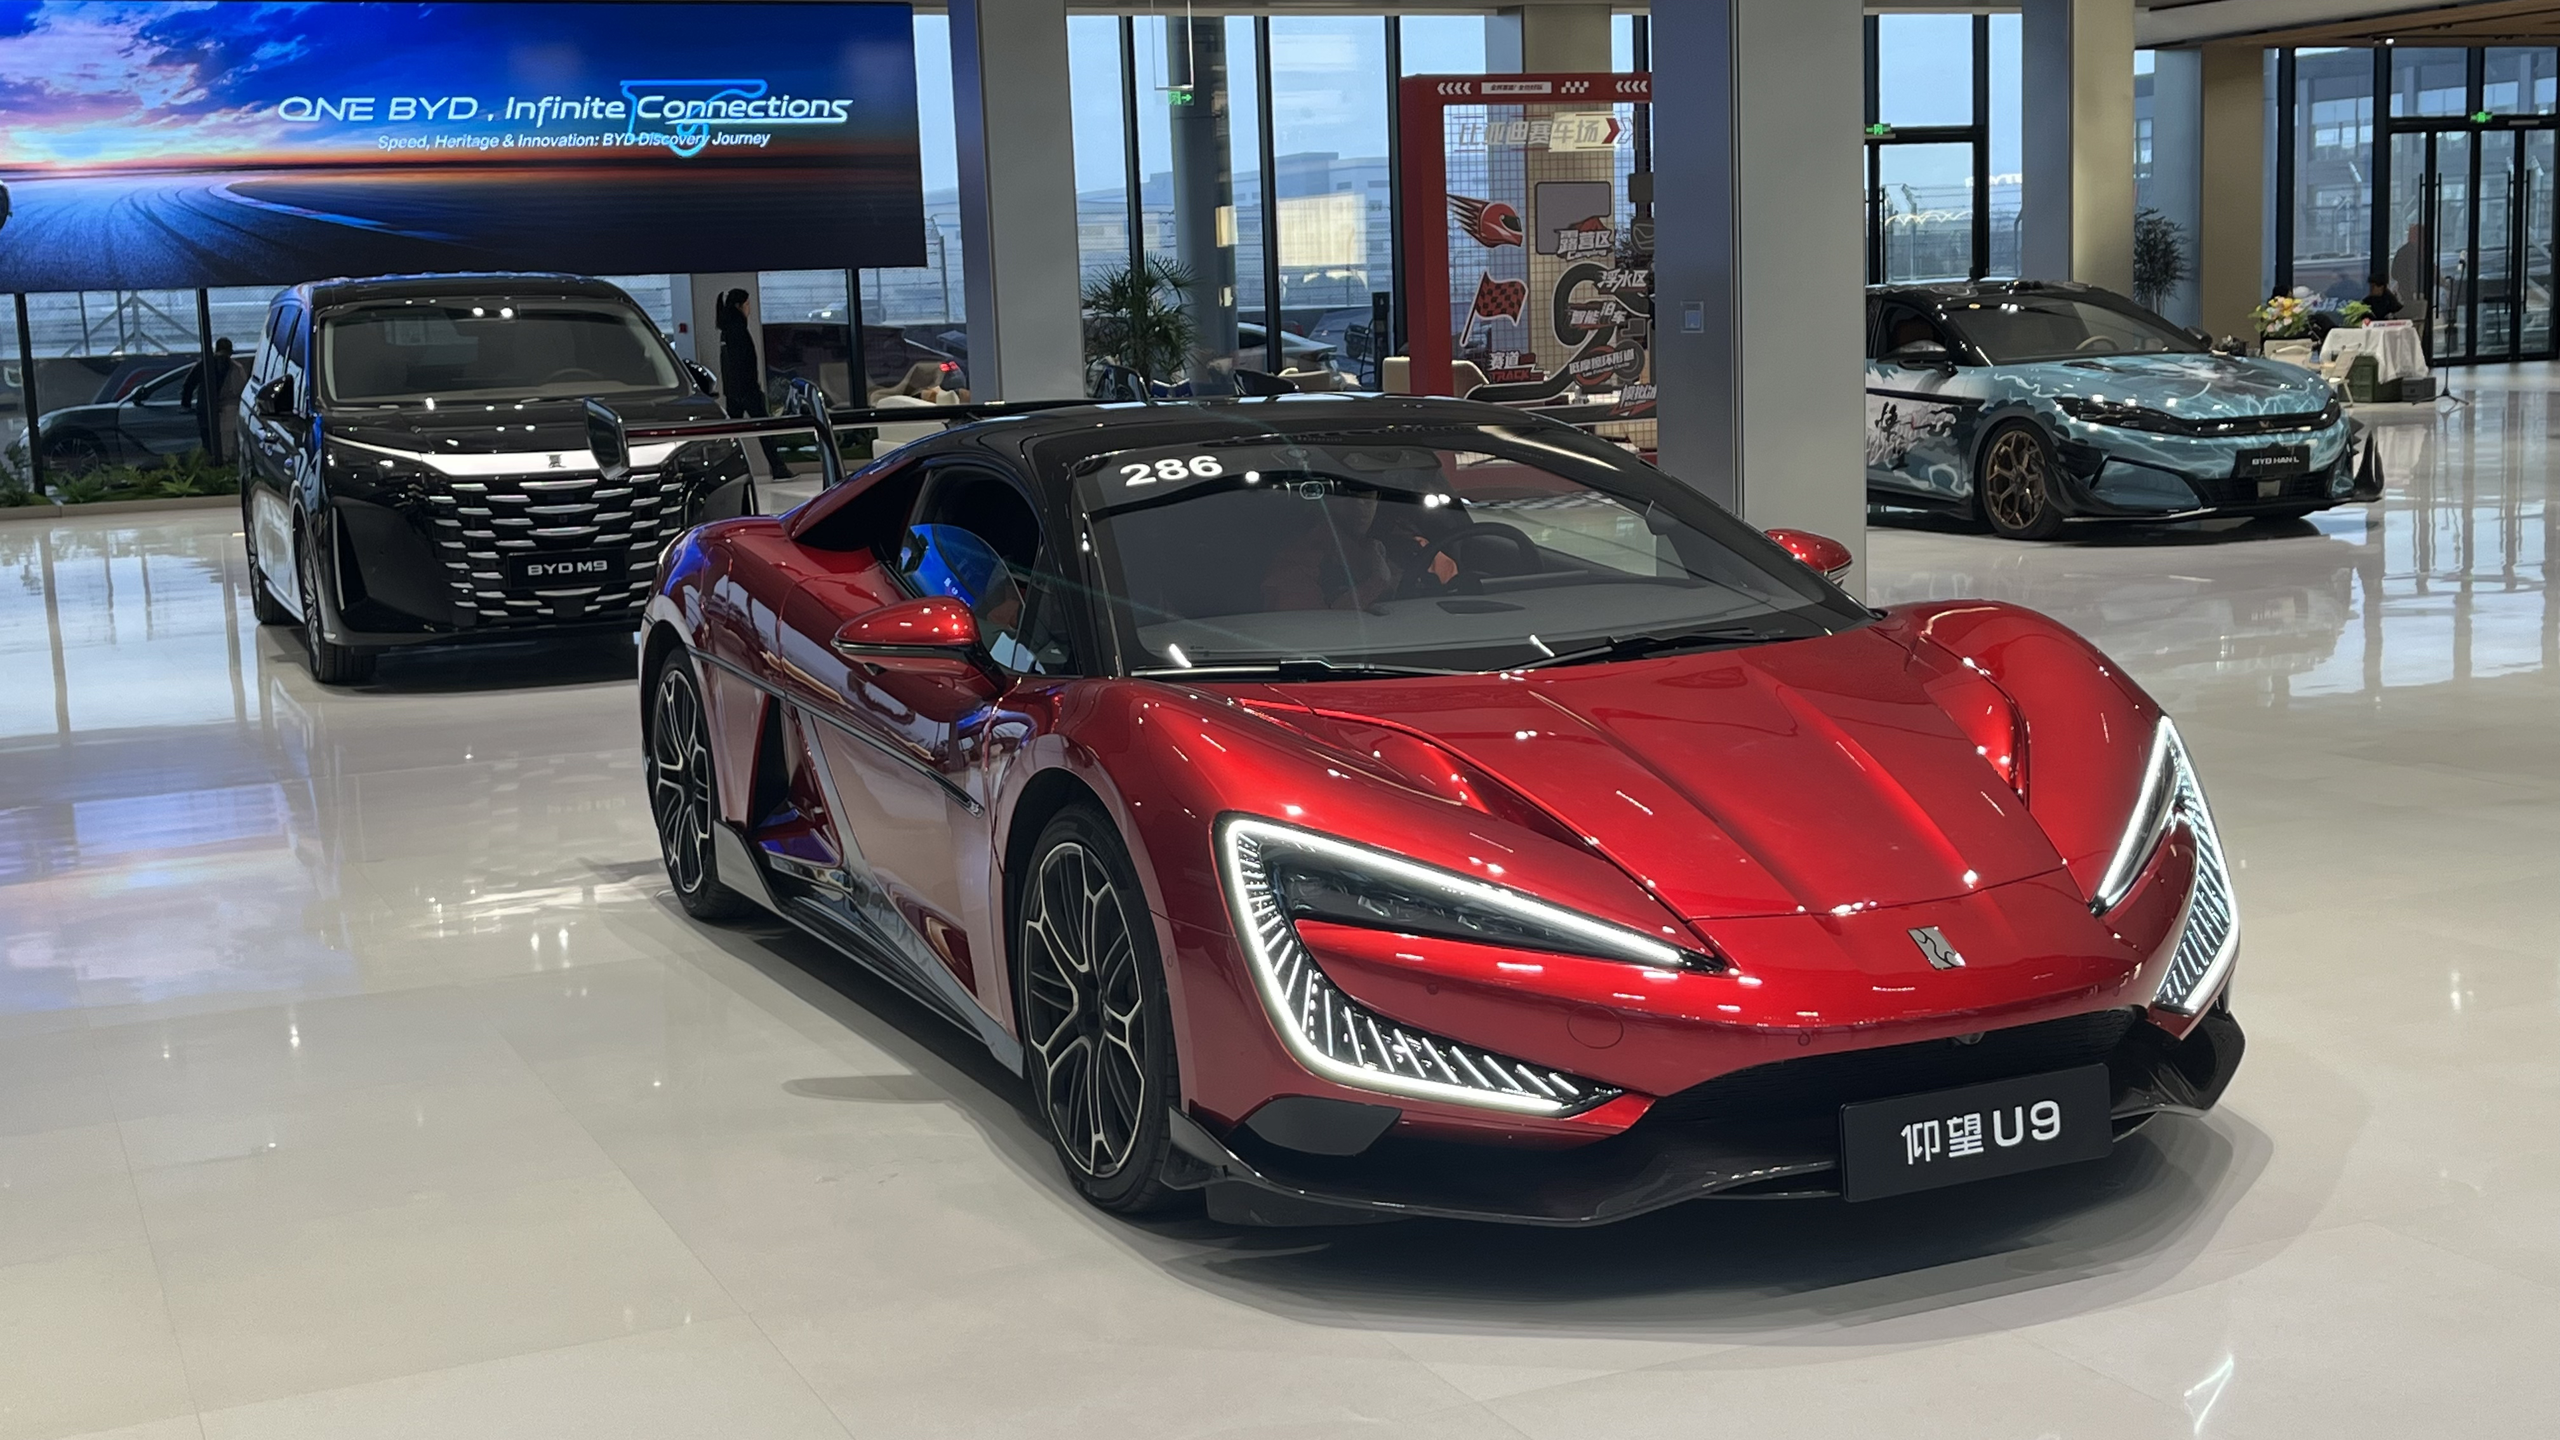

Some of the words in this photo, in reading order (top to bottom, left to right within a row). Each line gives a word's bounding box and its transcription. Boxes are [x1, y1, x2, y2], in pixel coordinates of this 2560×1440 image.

[278, 96, 375, 121] ONE
[388, 96, 479, 121] BYD
[505, 95, 626, 128] Infinite
[637, 94, 854, 123] Connections
[378, 135, 430, 151] Speed,
[434, 134, 499, 151] Heritage
[502, 134, 515, 148] &
[518, 133, 599, 148] Innovation:
[602, 133, 635, 146] BYD
[639, 132, 709, 147] Discovery
[711, 132, 771, 148] Journey
[1458, 118, 1600, 146] 比亚迪赛车场
[1557, 230, 1612, 254] 露营区
[1597, 268, 1649, 292] 浮水区
[1571, 302, 1627, 324] 智能泊车
[1487, 351, 1520, 371] 赛道
[1489, 369, 1531, 383] TRACK
[1120, 455, 1223, 487] 286
[2251, 457, 2273, 465] BYD
[527, 562, 573, 576] BYD
[577, 560, 608, 573] M9
[1900, 1112, 1985, 1165] 仰望
[1992, 1100, 2062, 1147] U9
